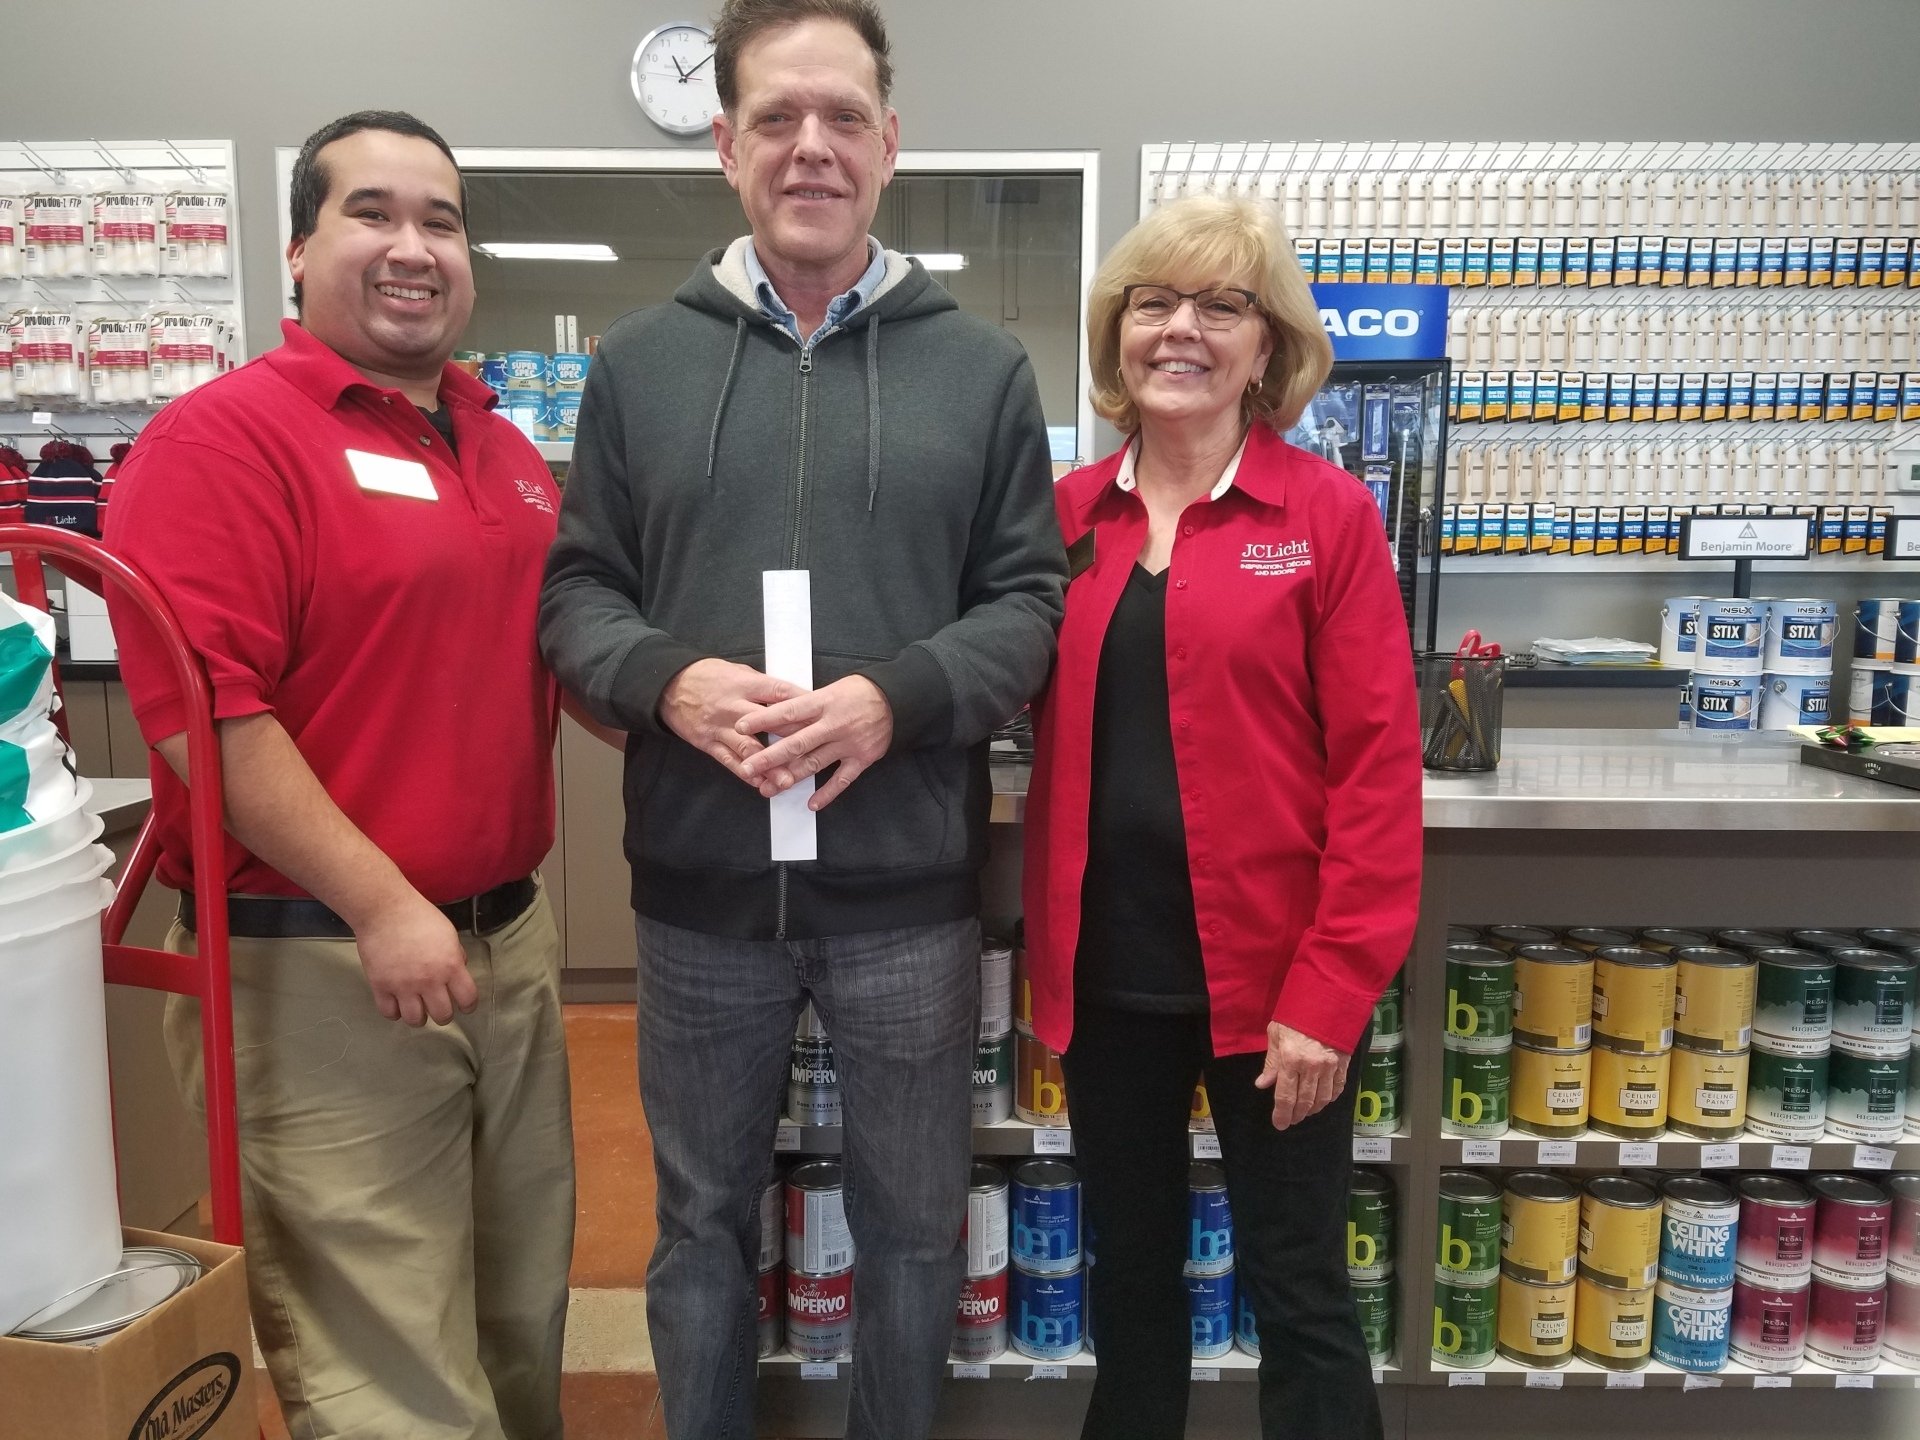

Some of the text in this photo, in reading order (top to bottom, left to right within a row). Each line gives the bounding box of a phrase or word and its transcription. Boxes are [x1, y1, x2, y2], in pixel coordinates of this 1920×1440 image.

[661, 39, 671, 48] 11
[678, 33, 689, 42] 12
[647, 54, 658, 62] 10
[640, 74, 646, 82] 9
[647, 95, 653, 103] 8
[662, 110, 668, 118] 7
[682, 115, 688, 123] 6
[1320, 308, 1420, 337] ACO
[512, 362, 537, 370] SUPER
[515, 369, 535, 377] SPEC
[1242, 539, 1310, 558] JCLicht
[1701, 541, 1792, 553] Benjamin Moore
[1713, 625, 1739, 639] STIX
[1789, 625, 1816, 638] STIX
[1703, 697, 1728, 711] STIX
[1808, 698, 1827, 711] STIX
[795, 1044, 827, 1055] Benjamin
[978, 1046, 1001, 1055] Moore
[792, 1063, 836, 1084] IMPERV
[1701, 1092, 1734, 1100] CEILING
[1014, 1208, 1067, 1260] ben
[1667, 1218, 1730, 1243] CEILING
[1671, 1235, 1726, 1257] WHITE
[1690, 1274, 1718, 1284] Moore
[796, 1284, 826, 1298] Satin
[788, 1288, 846, 1315] IMPERVO
[1668, 1305, 1728, 1326] CEILING
[1022, 1299, 1078, 1347] ben
[1673, 1321, 1724, 1341] WHITE
[1654, 1345, 1718, 1367] Benjamin Moore
[171, 1373, 227, 1433] Masters
